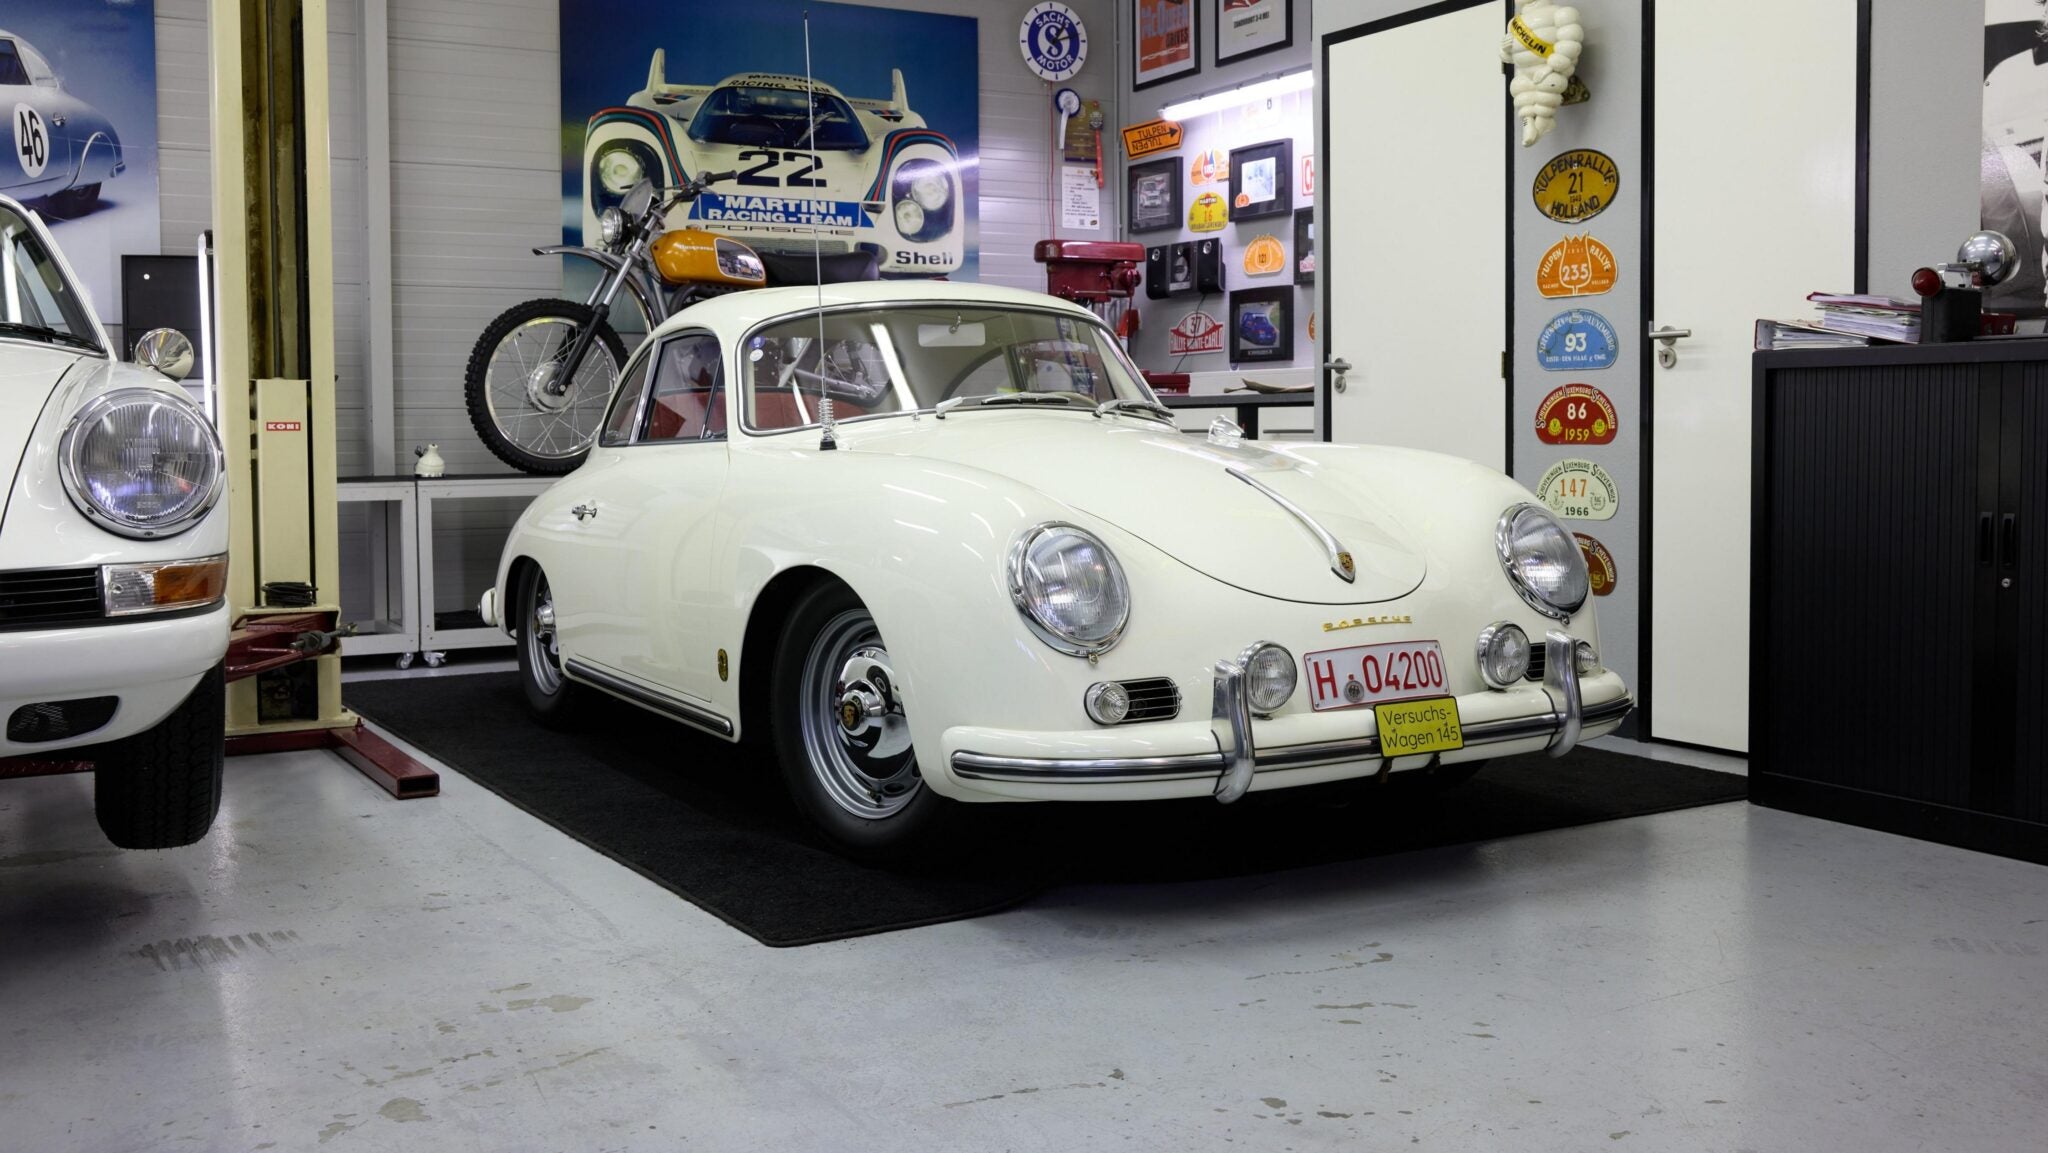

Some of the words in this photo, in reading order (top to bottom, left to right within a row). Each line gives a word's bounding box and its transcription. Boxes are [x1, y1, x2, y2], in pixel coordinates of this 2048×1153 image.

[1036, 12, 1070, 28] SACHS
[1511, 18, 1547, 55] MICHELIN
[1037, 54, 1074, 71] MOTOR
[747, 74, 814, 84] MARTINI
[18, 110, 45, 168] 46
[1138, 124, 1167, 139] TULPEN
[1132, 136, 1162, 152] TULPEN
[737, 150, 827, 187] 22
[1568, 171, 1584, 194] 21
[725, 195, 836, 214] MARTINI
[1551, 195, 1600, 218] HOLLAND
[1204, 209, 1213, 222] 16
[706, 225, 854, 236] PORSCHE
[896, 250, 954, 266] Shell
[1541, 248, 1562, 278] TULPEN
[1590, 245, 1612, 272] RALLYE
[1562, 263, 1589, 282] 235
[1190, 316, 1202, 334] 37
[1564, 333, 1587, 353] 93
[1567, 402, 1587, 420] 86
[1565, 428, 1590, 441] 1959
[1560, 478, 1587, 497] 147
[1565, 506, 1589, 516] 1966
[1322, 615, 1413, 632] PORSCHE
[1313, 659, 1338, 701] H
[1362, 650, 1443, 694] 04200
[1383, 706, 1452, 726] Versuchs-
[1382, 729, 1434, 750] Wagen
[1437, 726, 1459, 742] 145
